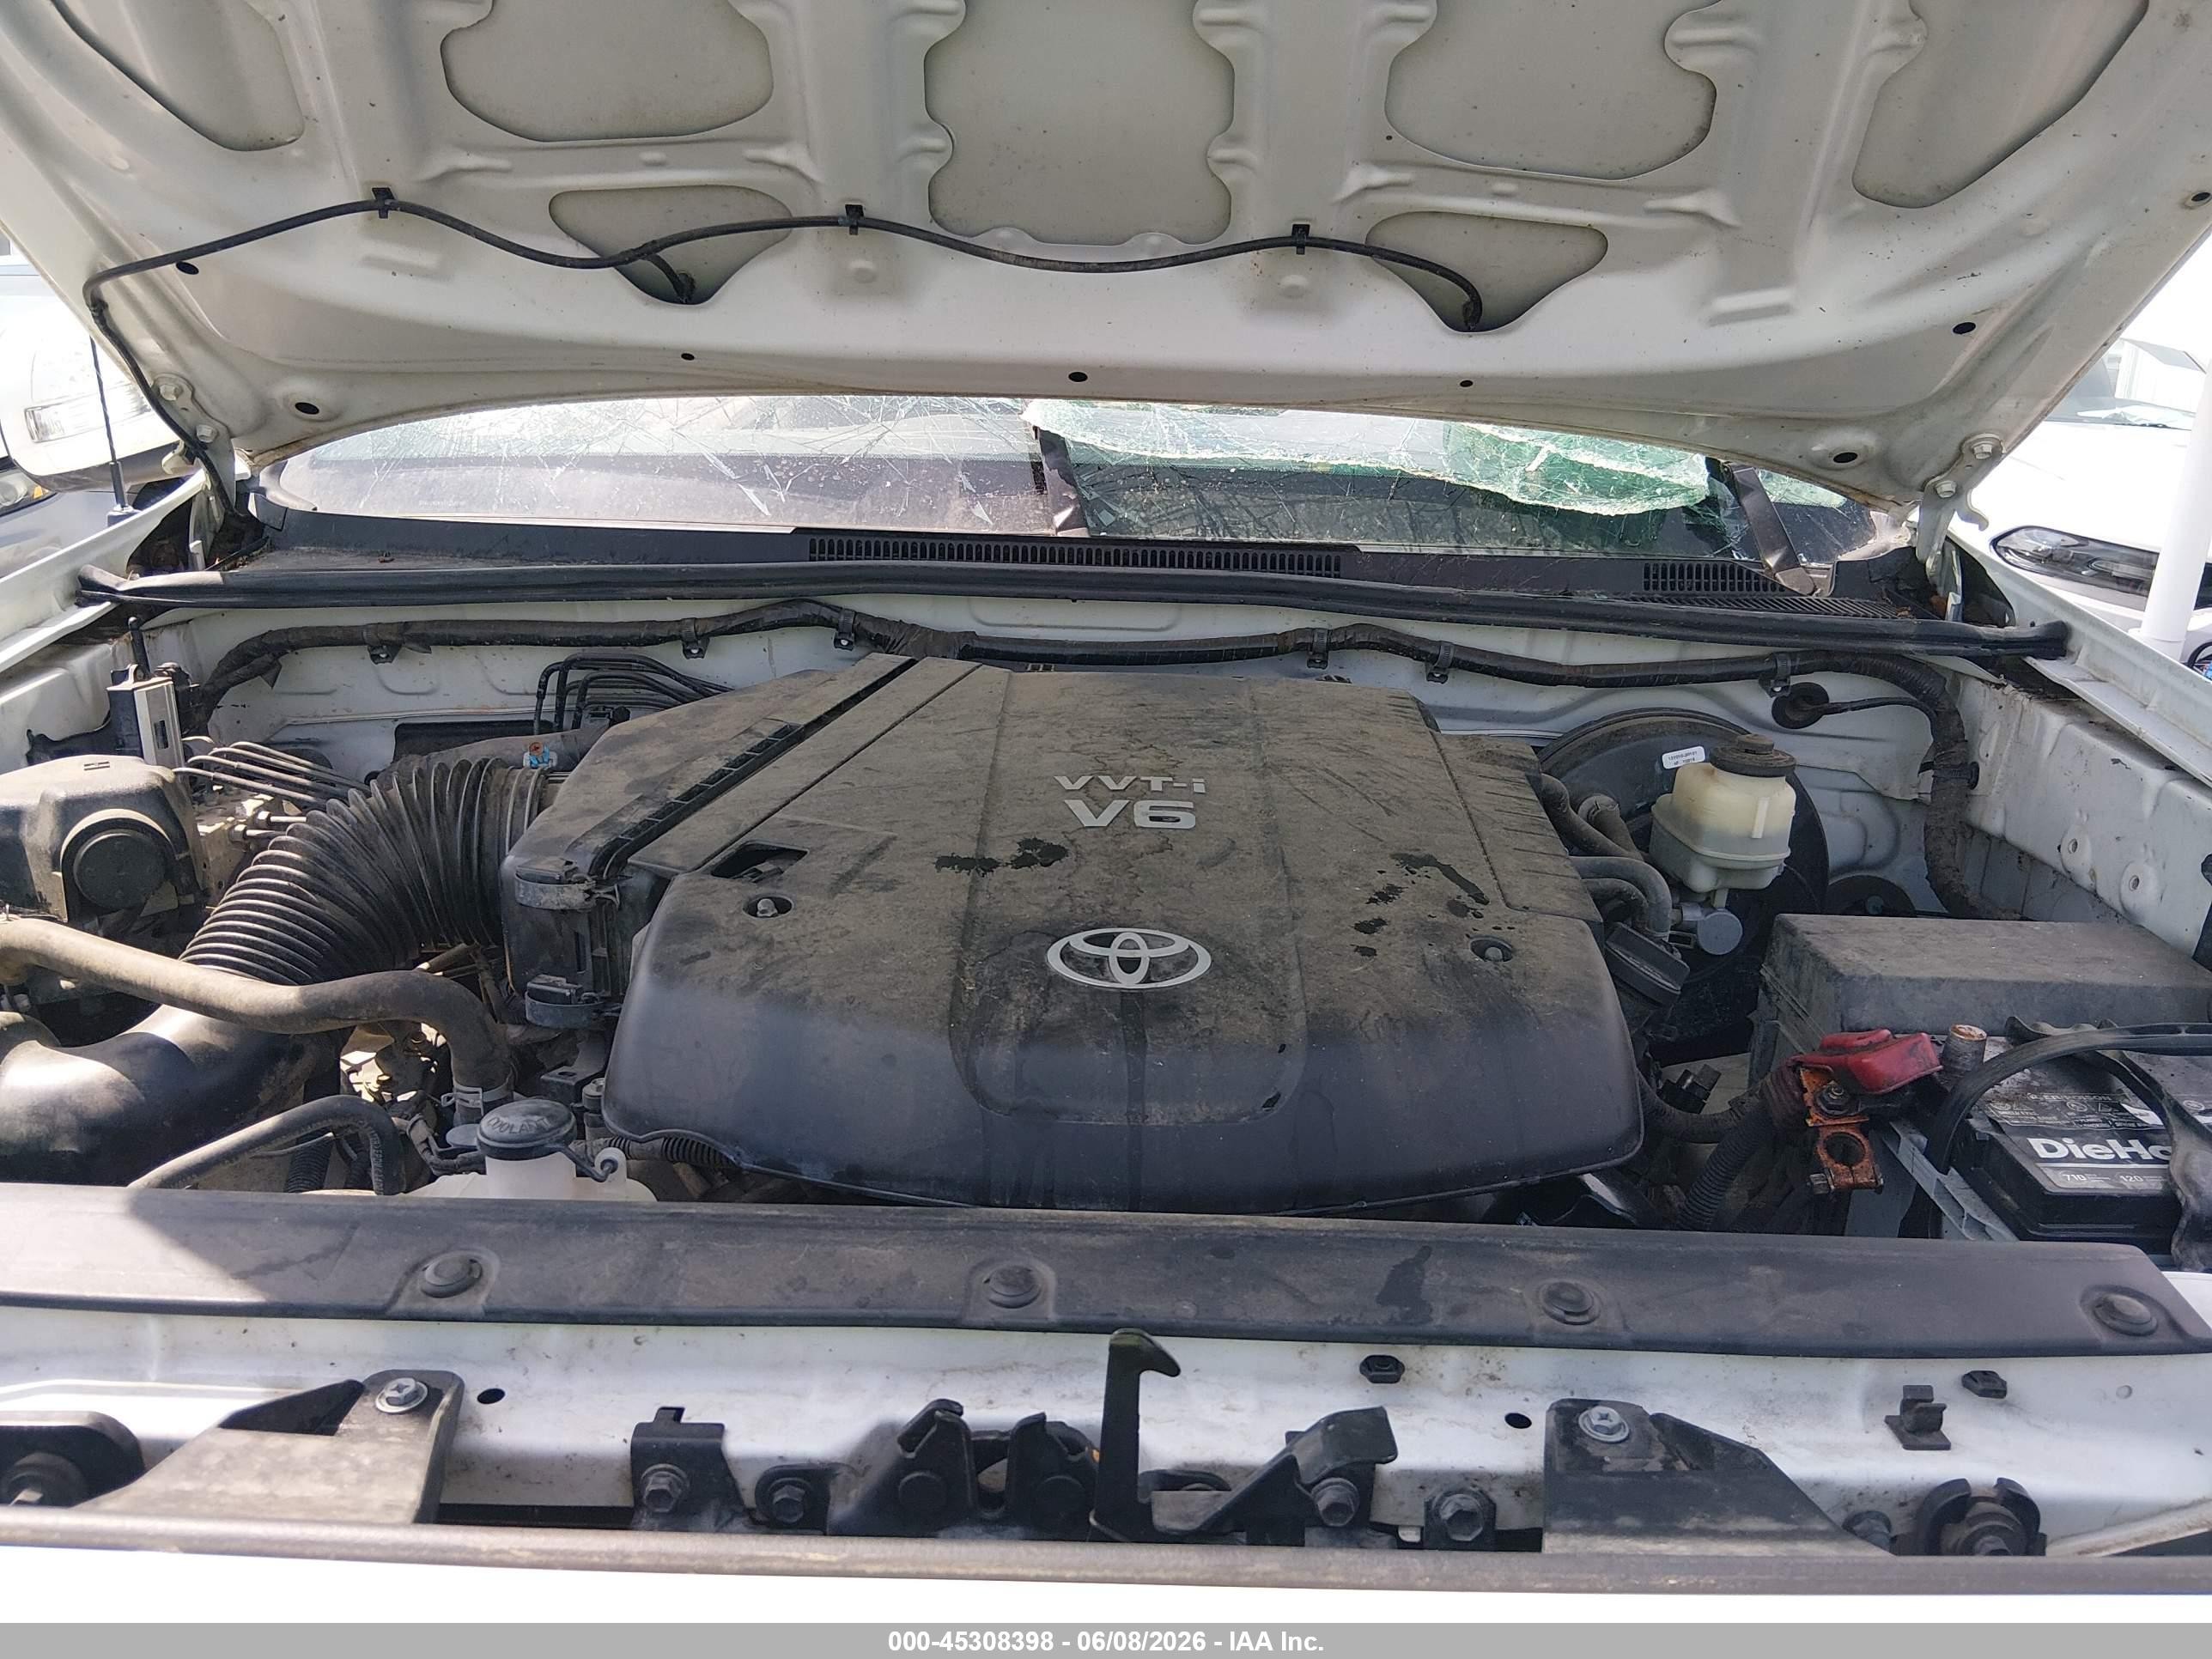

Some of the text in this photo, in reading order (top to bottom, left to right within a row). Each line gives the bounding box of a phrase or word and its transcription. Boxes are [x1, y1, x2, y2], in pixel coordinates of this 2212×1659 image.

[1054, 775, 1206, 793] VVT-i
[1063, 799, 1196, 830] V6
[487, 1116, 551, 1134] COOLANT
[2063, 1173, 2087, 1182] 710
